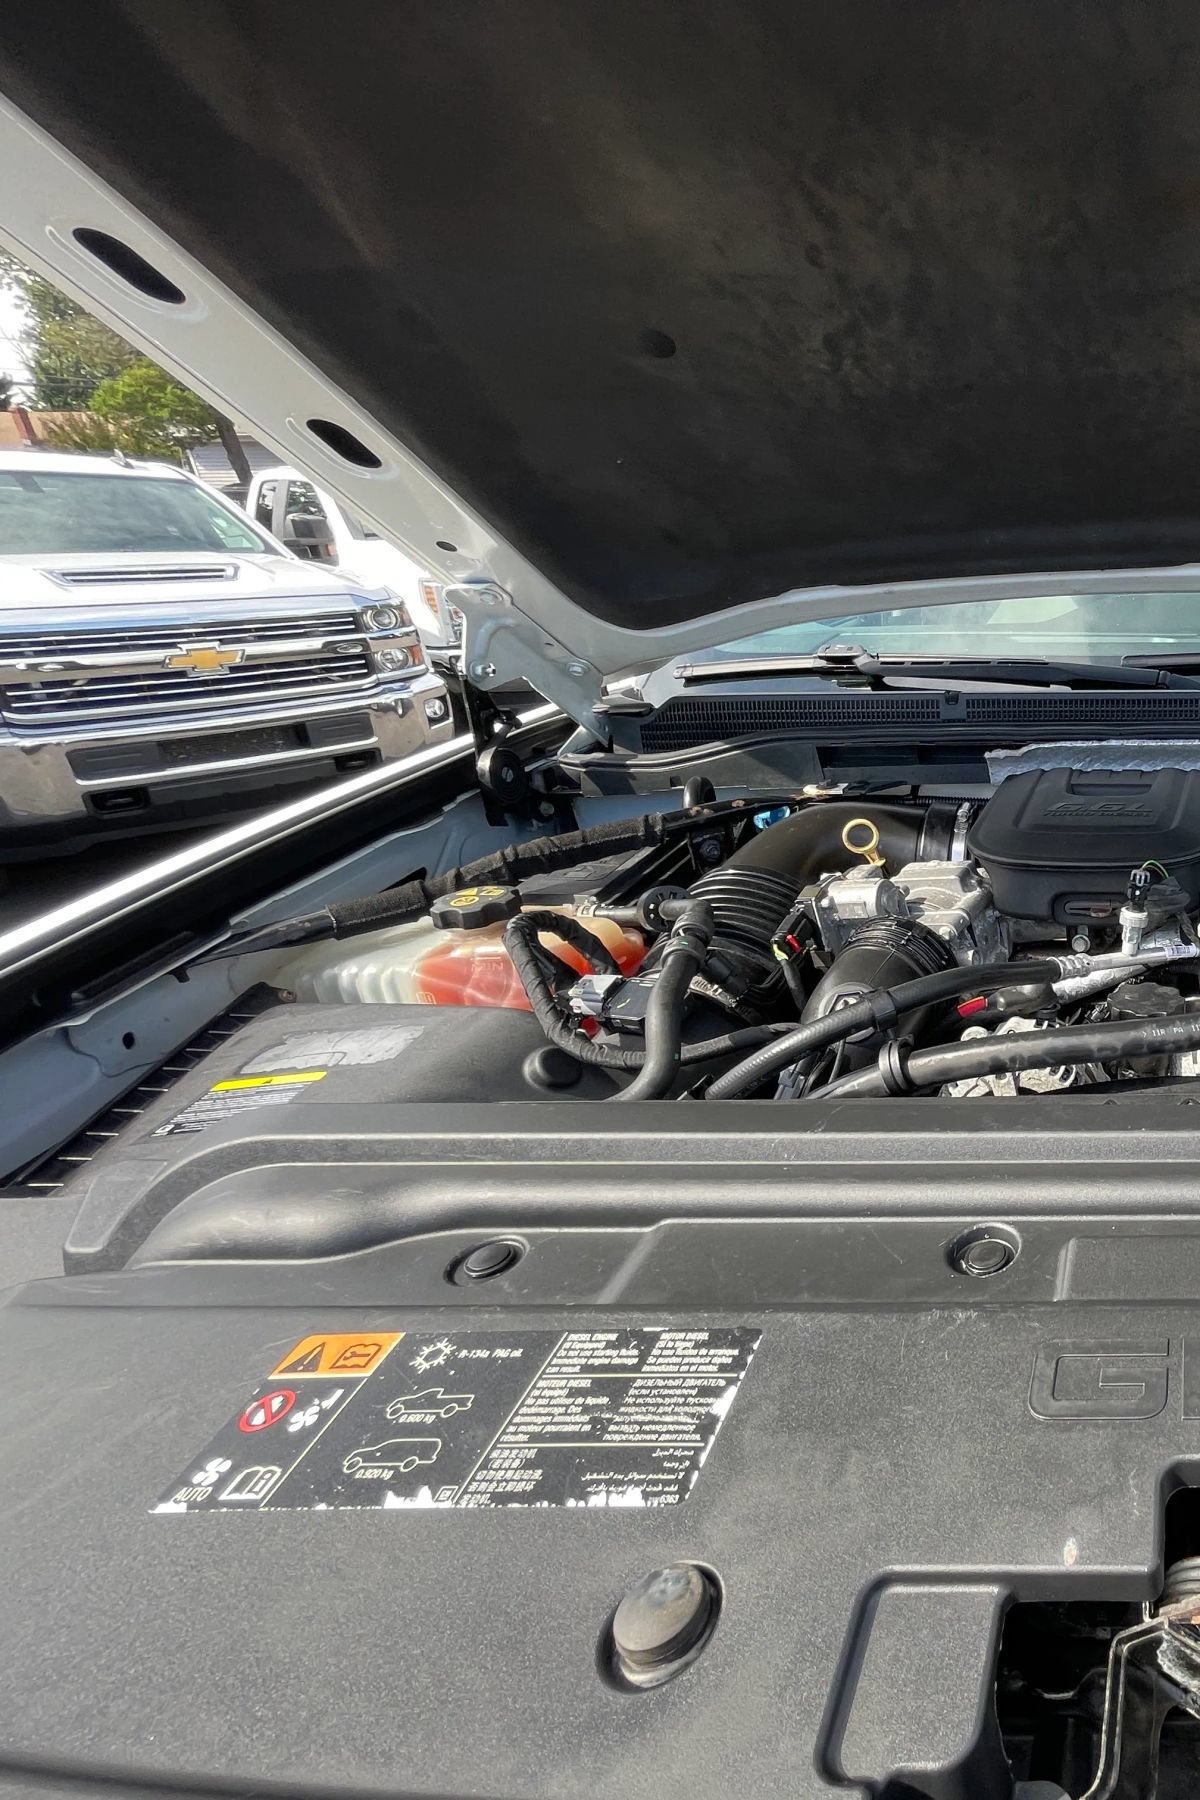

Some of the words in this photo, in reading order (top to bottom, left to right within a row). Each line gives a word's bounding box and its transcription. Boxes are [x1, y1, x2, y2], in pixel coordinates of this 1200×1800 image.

[491, 1348, 511, 1358] PAG
[634, 1378, 682, 1386] ДИЗЕЛЬНЫЙ
[512, 1415, 552, 1423] dommages
[355, 1469, 382, 1479] 0.920
[381, 1469, 395, 1480] kg
[175, 1487, 213, 1501] AUTO
